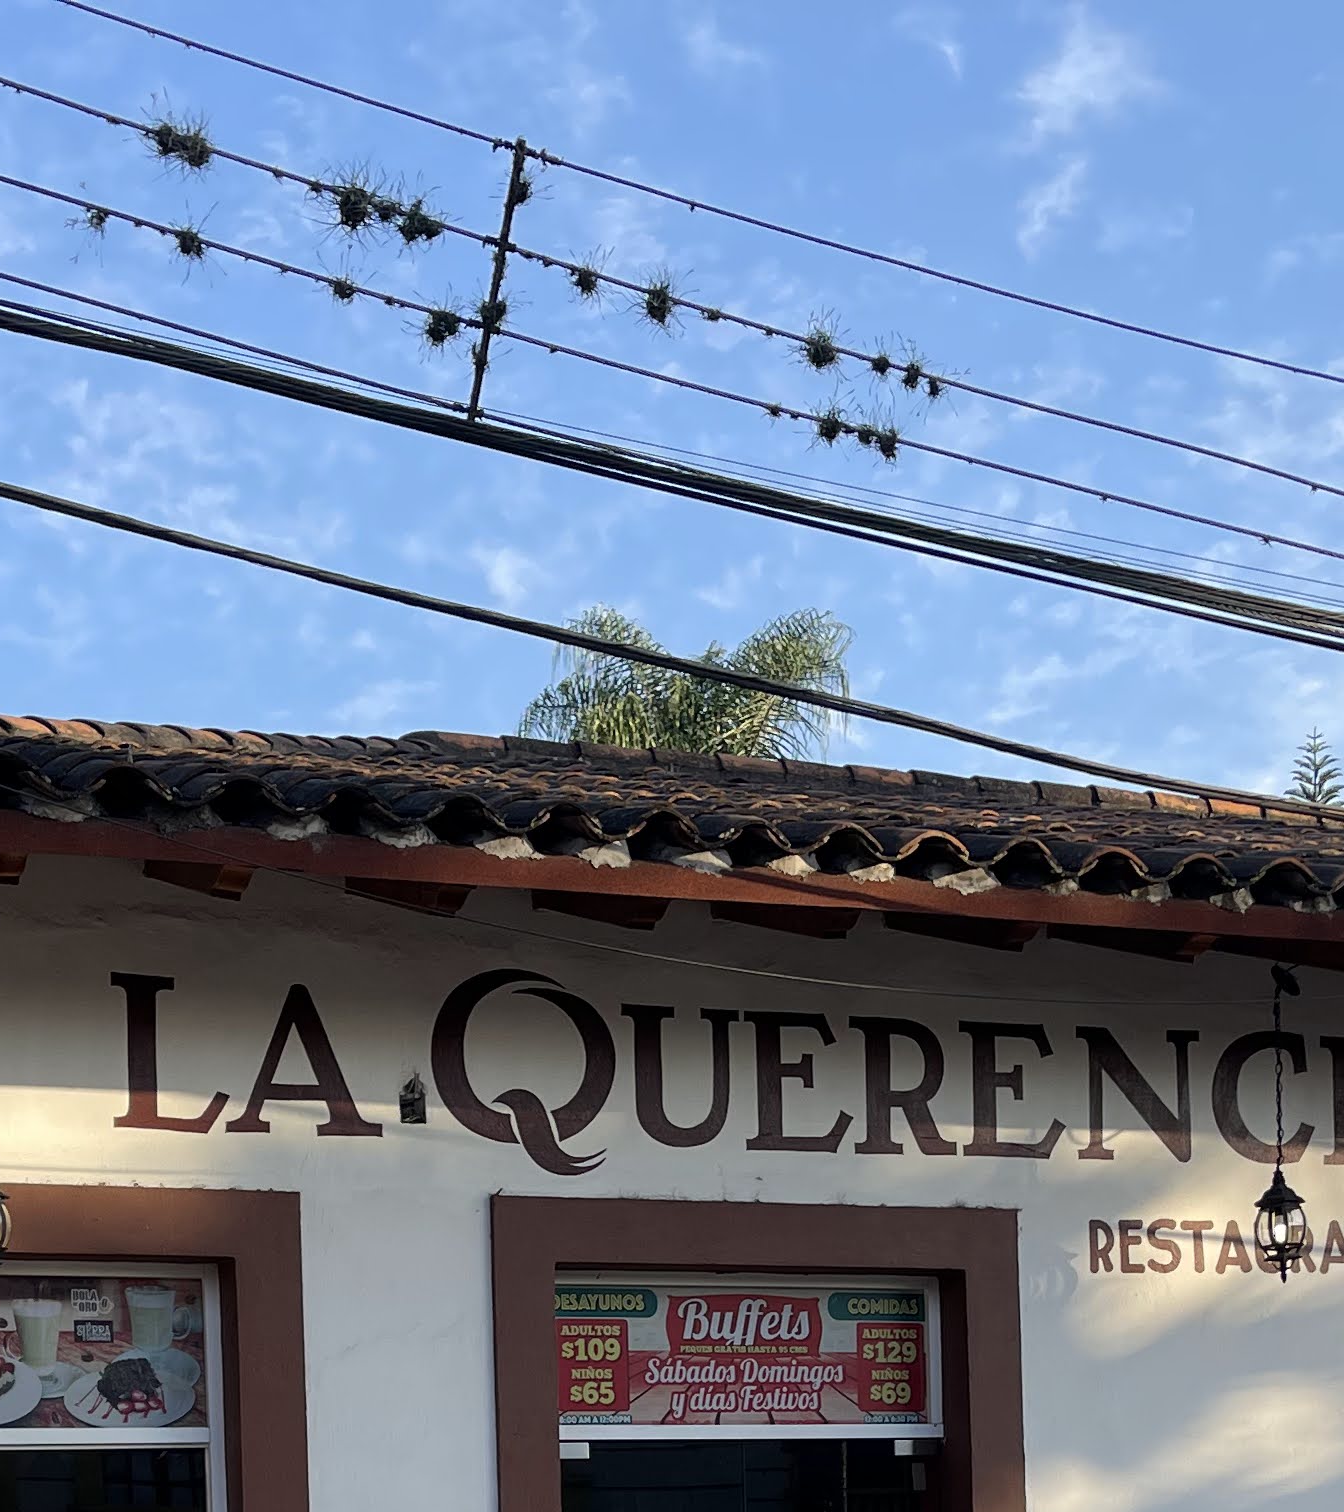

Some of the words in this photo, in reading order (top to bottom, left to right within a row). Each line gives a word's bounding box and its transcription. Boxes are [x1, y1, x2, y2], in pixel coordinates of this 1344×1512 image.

[111, 971, 383, 1138] LA
[847, 1298, 920, 1316] COMIDAS
[560, 1325, 621, 1337] ADULTOS
[677, 1298, 811, 1347] Buffets
[862, 1328, 918, 1340] ADULTOS
[561, 1338, 622, 1362] $109
[862, 1342, 918, 1365] $129
[570, 1366, 614, 1380] NIÑOS
[644, 1358, 736, 1384] Sábados
[740, 1358, 844, 1389] Domingos
[871, 1368, 910, 1381] NIÑOS
[569, 1382, 616, 1406] $65
[672, 1390, 687, 1419] y
[690, 1386, 737, 1411] días
[740, 1386, 821, 1412] Festivos
[869, 1382, 913, 1406] $69
